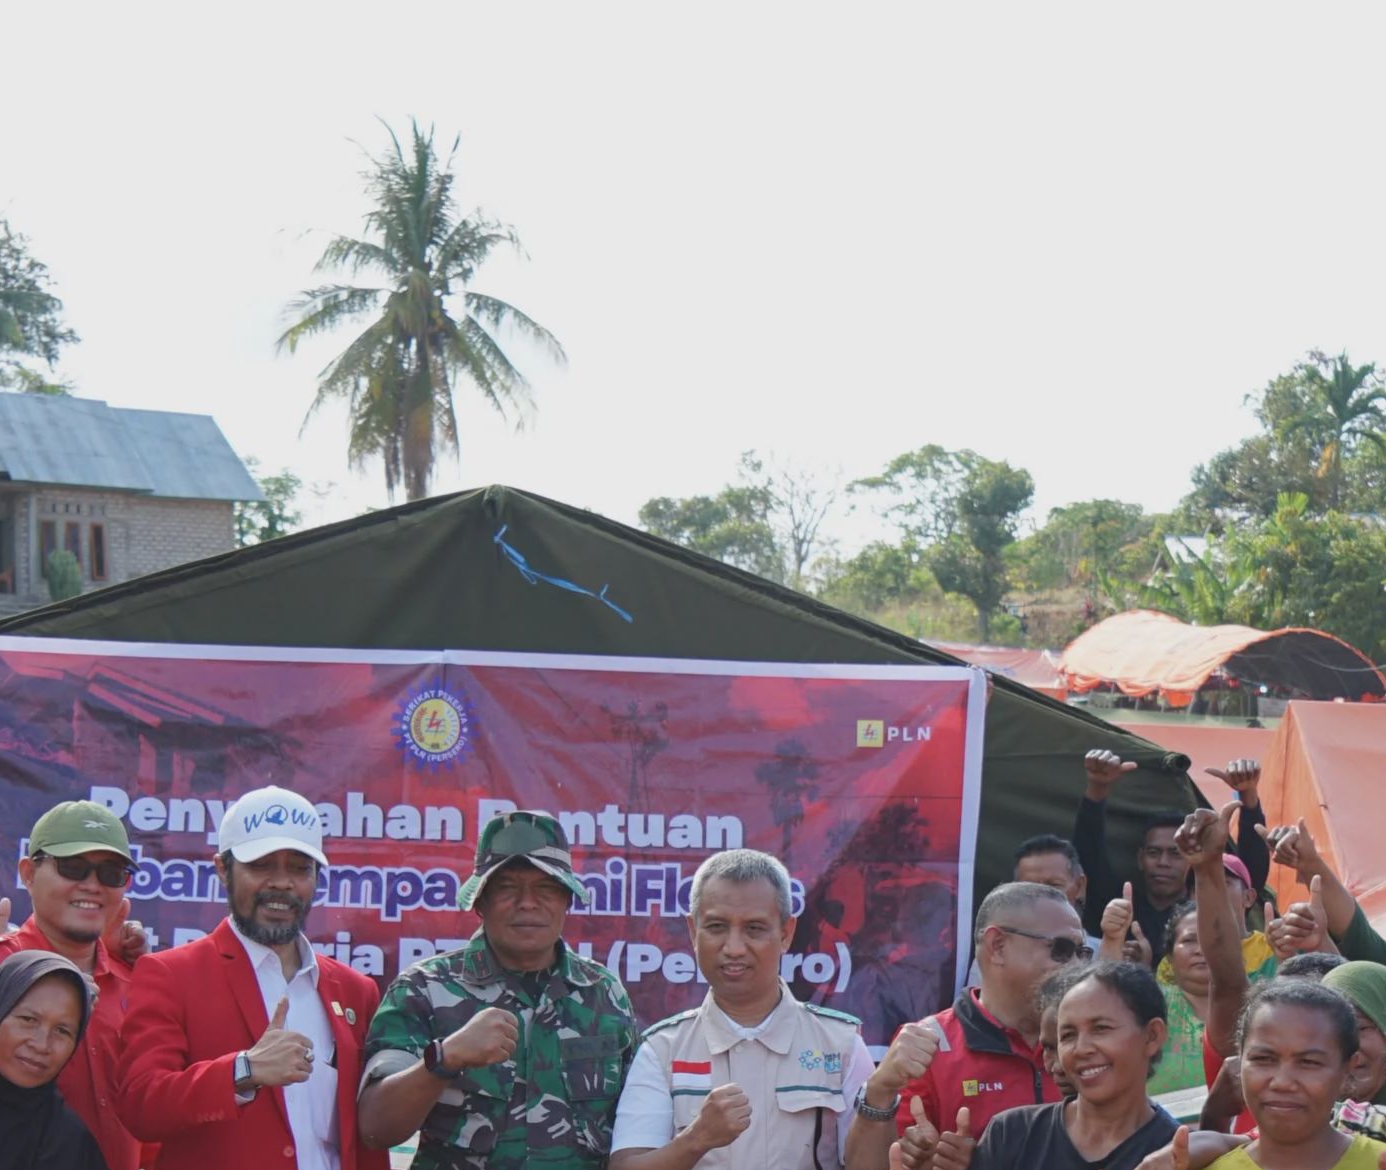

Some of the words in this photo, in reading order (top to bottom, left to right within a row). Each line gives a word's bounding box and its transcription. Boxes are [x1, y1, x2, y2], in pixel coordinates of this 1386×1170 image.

[403, 689, 436, 722] SERIKAT
[437, 689, 469, 724] PEKERJA
[886, 726, 932, 742] PLN
[607, 940, 853, 994] (Pero)
[979, 1082, 1003, 1092] PLN
